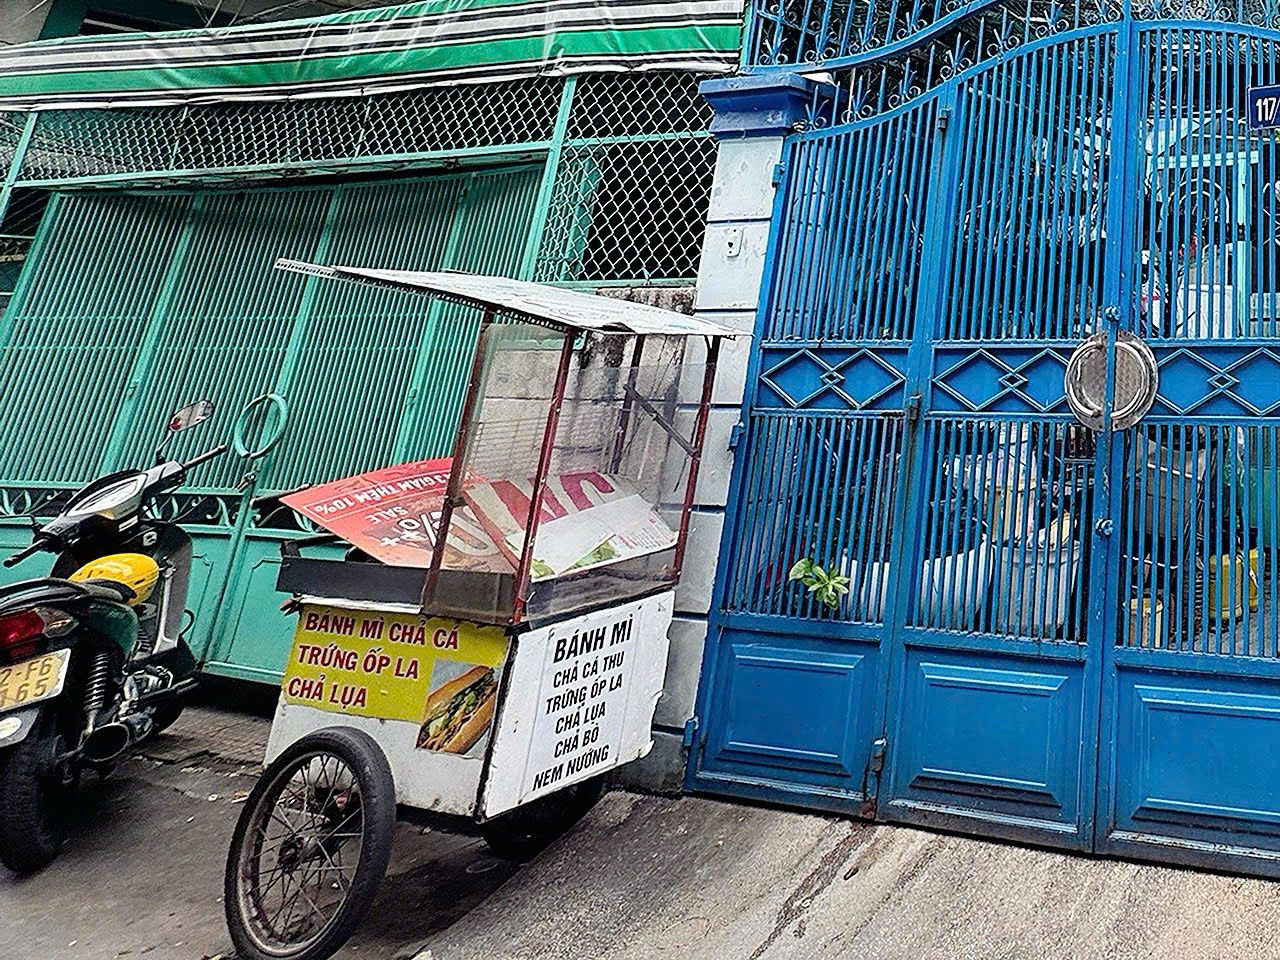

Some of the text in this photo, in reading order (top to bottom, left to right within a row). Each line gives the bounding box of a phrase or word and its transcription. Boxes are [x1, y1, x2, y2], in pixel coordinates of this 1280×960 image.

[313, 495, 355, 516] 10%
[357, 481, 397, 504] THÊM
[365, 504, 409, 526] SALE
[305, 611, 459, 650] BÁNH MÌ CHẢ CÁ
[553, 614, 633, 663] BÁNH MÌ
[298, 642, 419, 680] TRỨNG ỐP LA
[553, 651, 625, 688] CHẢ CÁ THU
[287, 674, 367, 710] CHẢ LỤA
[545, 685, 588, 715] TRỨNG
[609, 673, 623, 692] LA
[555, 701, 607, 735] CHẢ LỤA
[554, 722, 600, 758] CHẢ BÒ
[532, 744, 610, 791] NEM NƯỚNG
